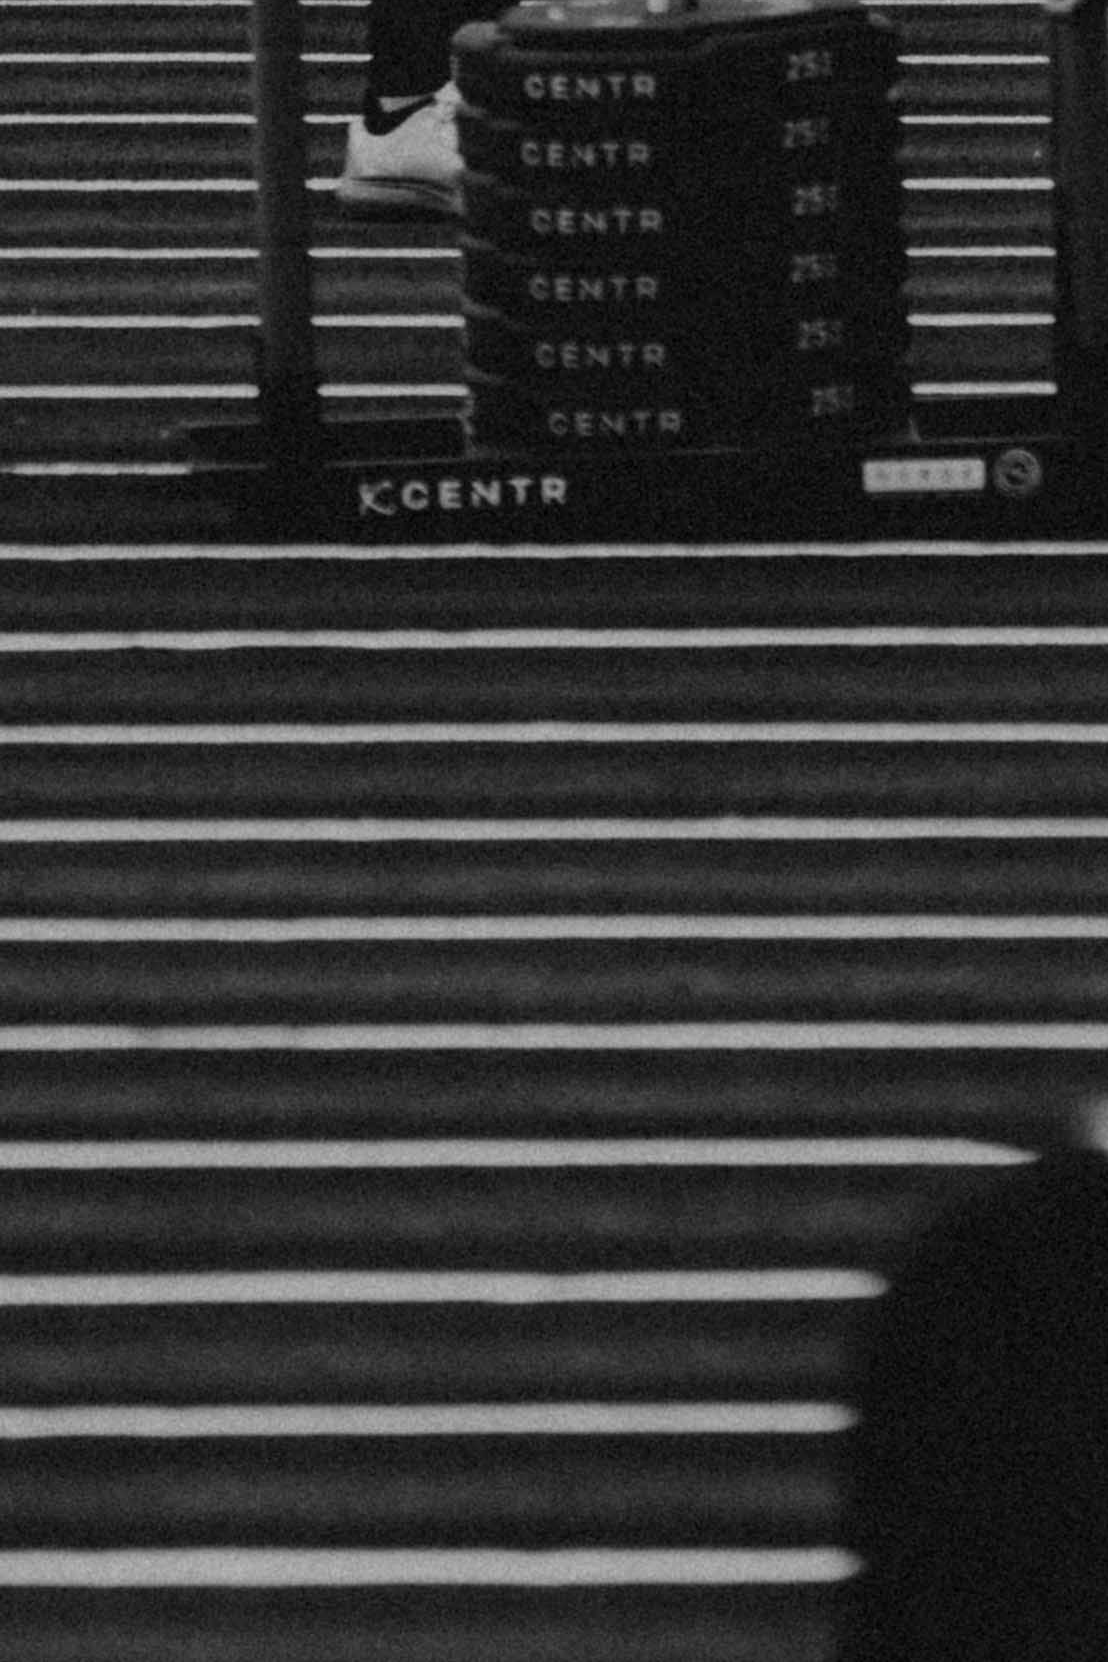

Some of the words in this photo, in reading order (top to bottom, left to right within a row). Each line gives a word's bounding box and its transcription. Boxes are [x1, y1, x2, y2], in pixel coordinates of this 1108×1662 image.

[524, 73, 656, 99] CENTR
[521, 140, 651, 167] CENTR
[532, 207, 662, 234] CENTR
[529, 274, 659, 301] CENTR
[535, 342, 666, 368] CENTR
[548, 410, 682, 436] CENTR
[401, 476, 567, 510] CENTR
